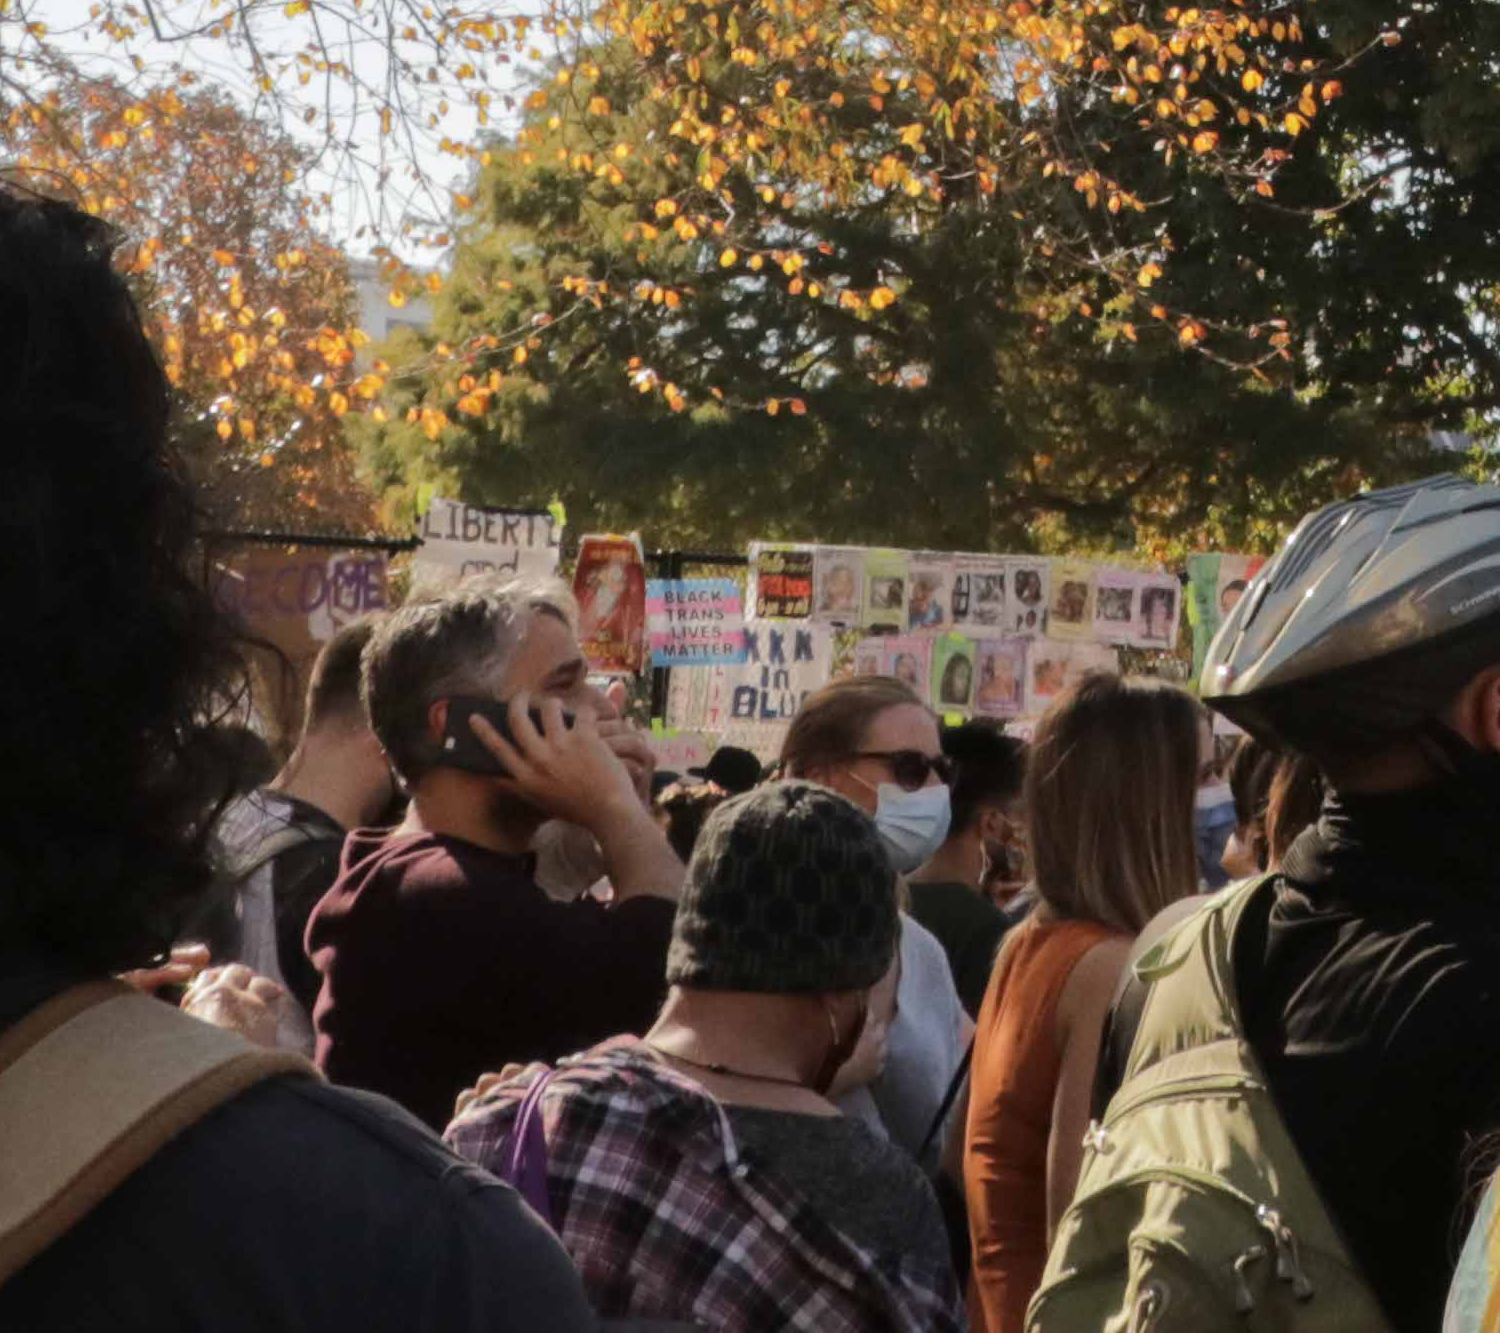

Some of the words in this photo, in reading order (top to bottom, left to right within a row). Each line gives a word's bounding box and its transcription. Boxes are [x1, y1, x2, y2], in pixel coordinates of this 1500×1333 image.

[422, 498, 562, 549] LIBERTY
[663, 590, 723, 605] BLACK
[665, 608, 725, 622] TRANS
[670, 626, 723, 639] LIVES
[663, 643, 734, 658] MATTER
